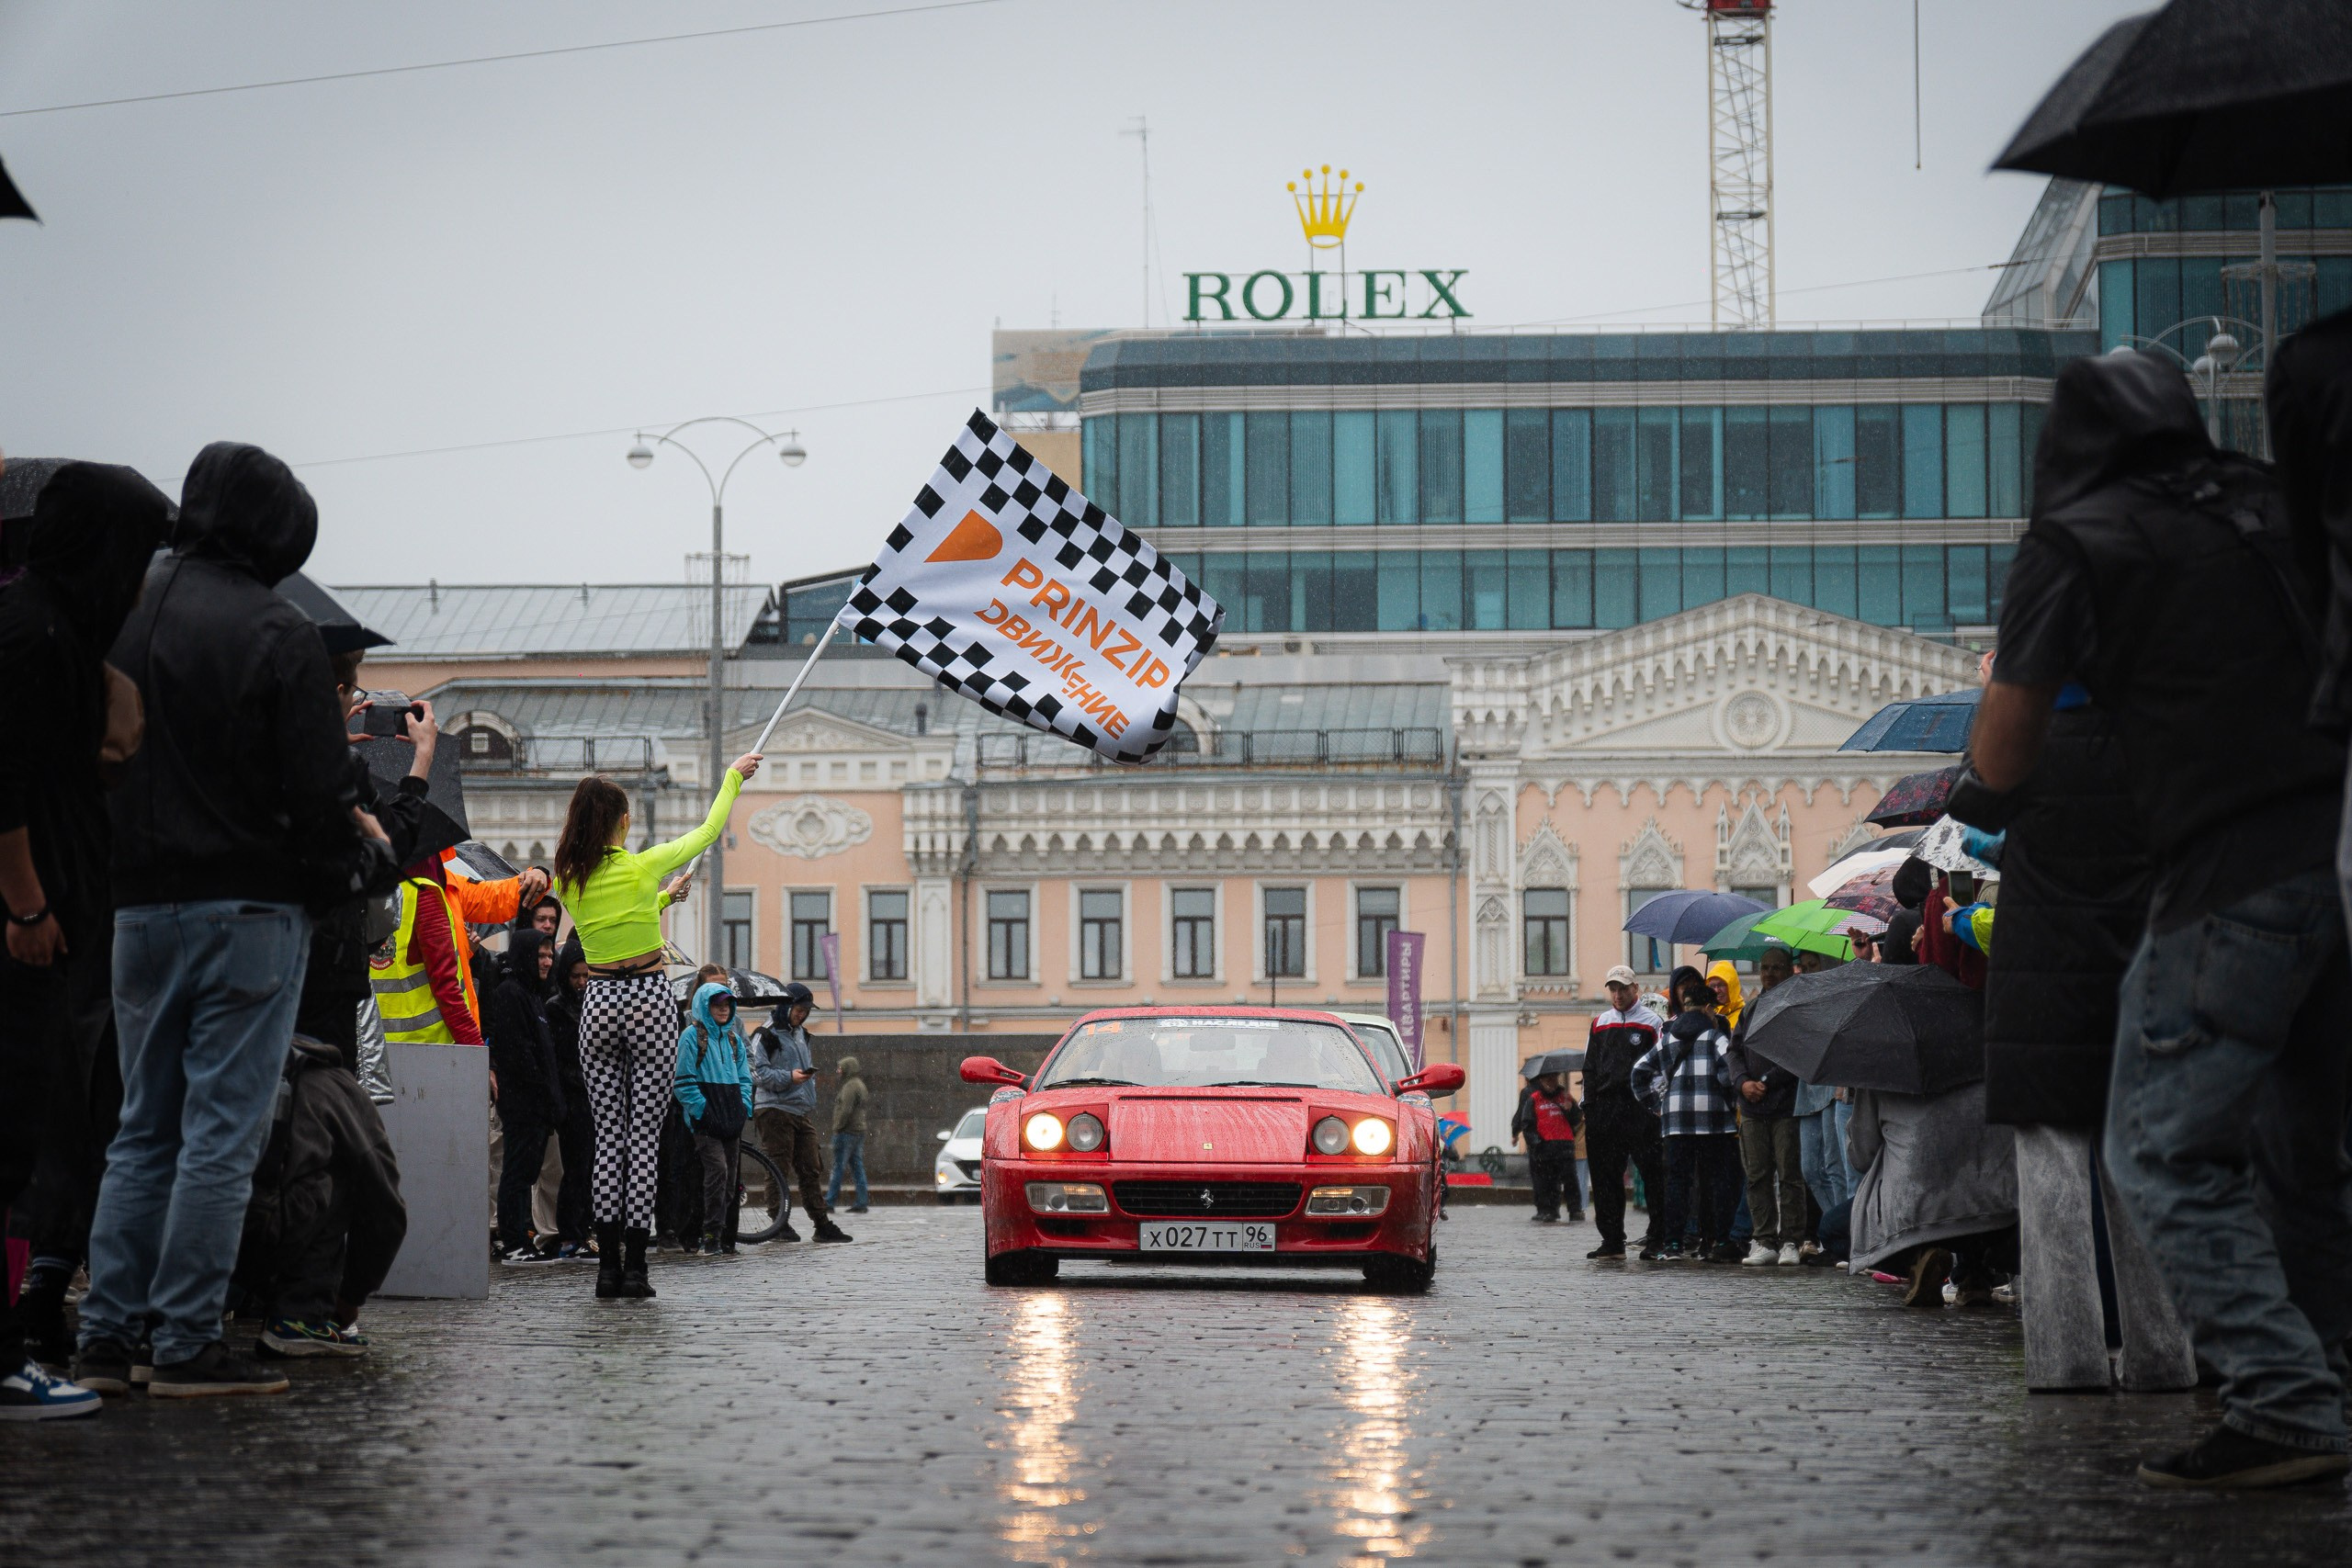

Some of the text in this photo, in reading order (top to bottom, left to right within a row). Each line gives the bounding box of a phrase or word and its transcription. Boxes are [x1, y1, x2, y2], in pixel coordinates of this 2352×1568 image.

[1182, 269, 1474, 321] ROLEX
[1000, 557, 1170, 689] PRINZIP
[1400, 942, 1414, 1036] КВАРТИРЫ
[1083, 1021, 1123, 1036] 14
[1246, 1225, 1267, 1242] 96
